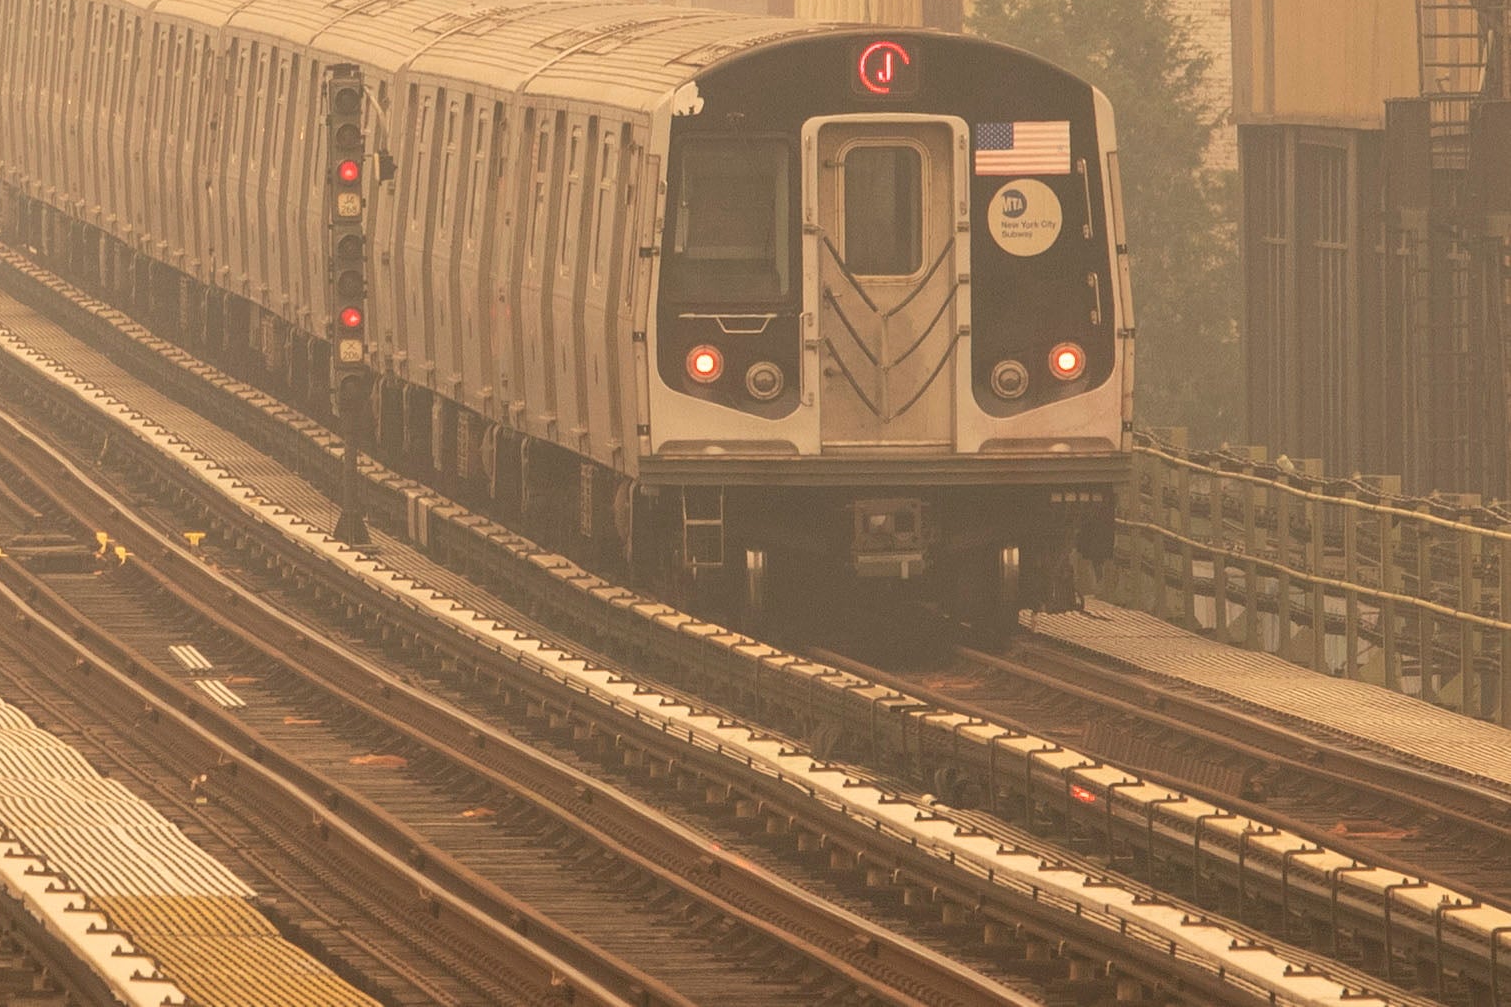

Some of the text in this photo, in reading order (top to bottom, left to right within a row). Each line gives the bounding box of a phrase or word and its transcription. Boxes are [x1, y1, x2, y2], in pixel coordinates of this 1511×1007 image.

[1001, 219, 1056, 230] New York City
[1001, 230, 1033, 239] Subway
